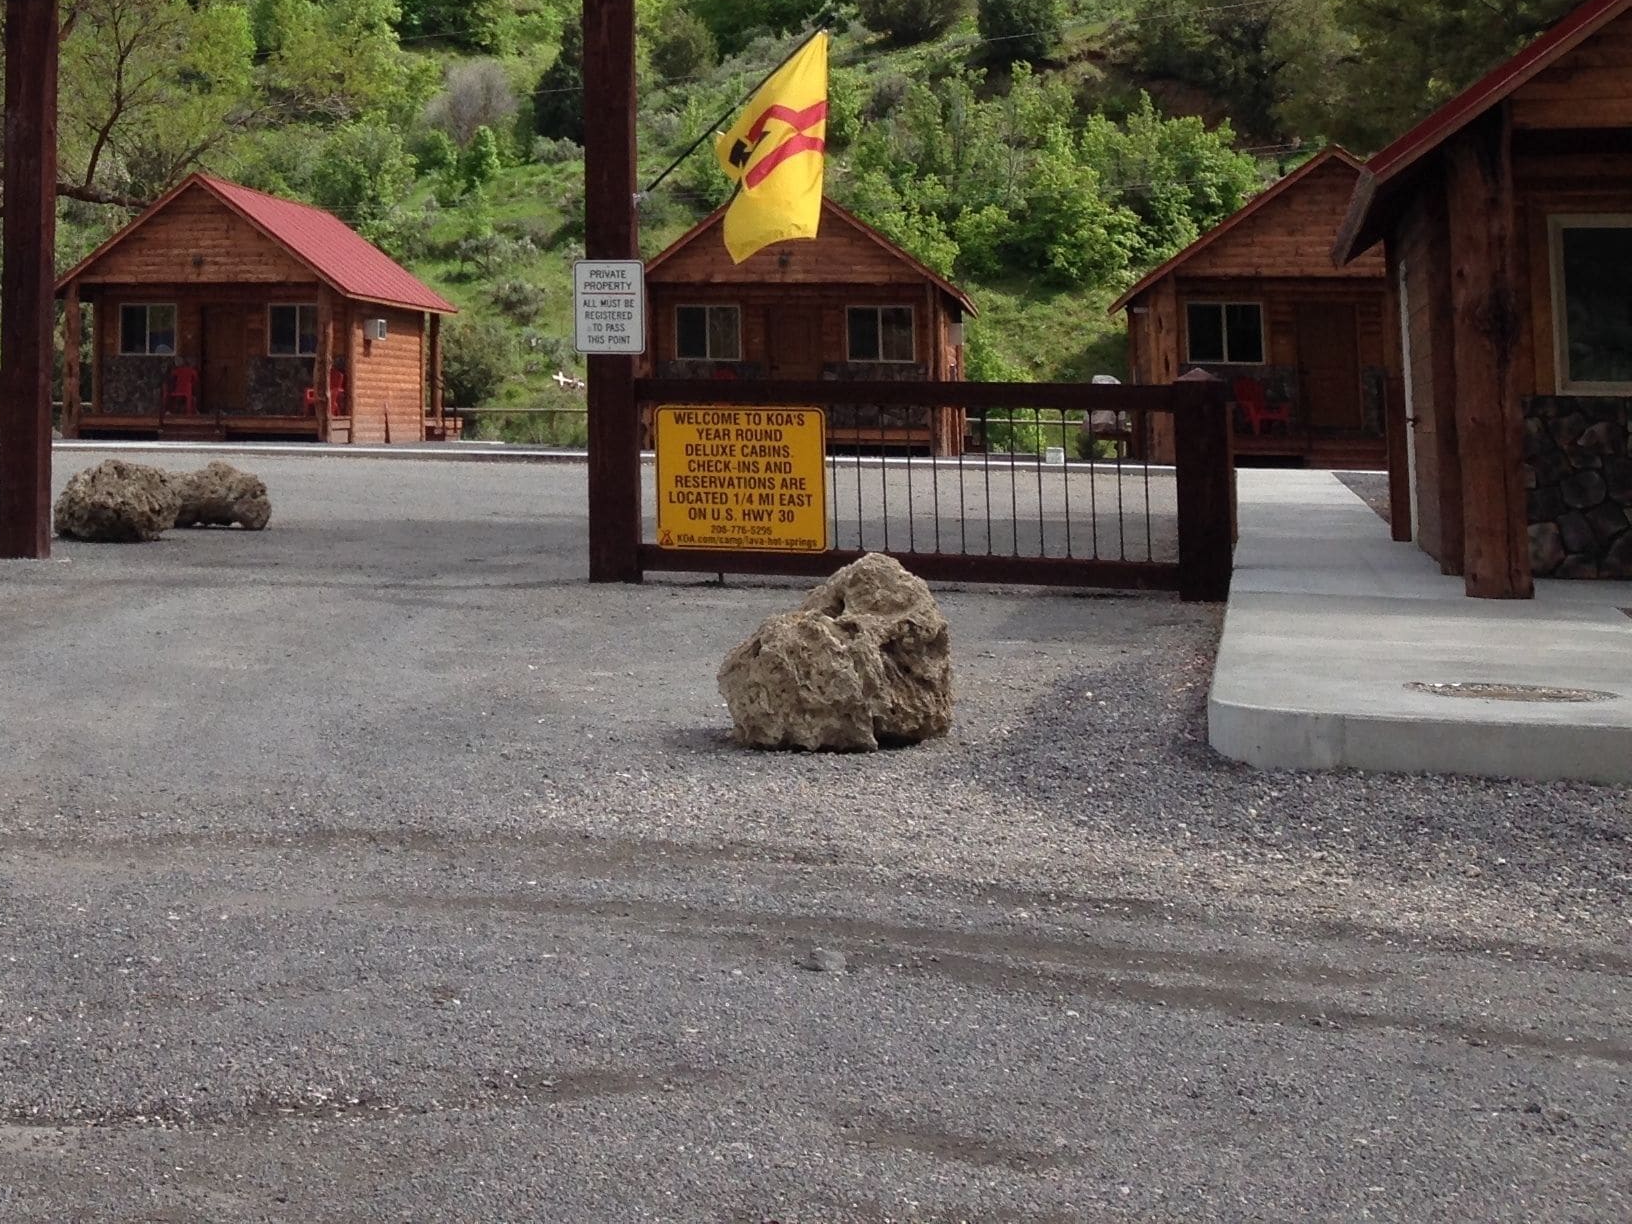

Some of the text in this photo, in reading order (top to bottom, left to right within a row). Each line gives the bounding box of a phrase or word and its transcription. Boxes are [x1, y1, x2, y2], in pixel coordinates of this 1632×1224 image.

[590, 270, 626, 278] PRIVATE
[584, 282, 632, 290] PROPERTY
[601, 299, 620, 307] MUST
[624, 299, 634, 307] BE
[585, 311, 632, 320] REGISTERED
[593, 323, 625, 332] TO PASS
[588, 335, 630, 344] THIS POINT
[674, 412, 805, 426] WELCOME TO KOA'S
[696, 429, 782, 441] YEAR ROUND
[685, 444, 794, 458] DELUXE CABINS.
[688, 460, 792, 474] CHECK-INS AND
[675, 476, 805, 490] RESERVATIONS ARE
[669, 492, 812, 507] LOCATED 1/4 MI EAST
[688, 508, 706, 520] ON
[743, 509, 772, 521] HWY
[779, 510, 794, 522] 30
